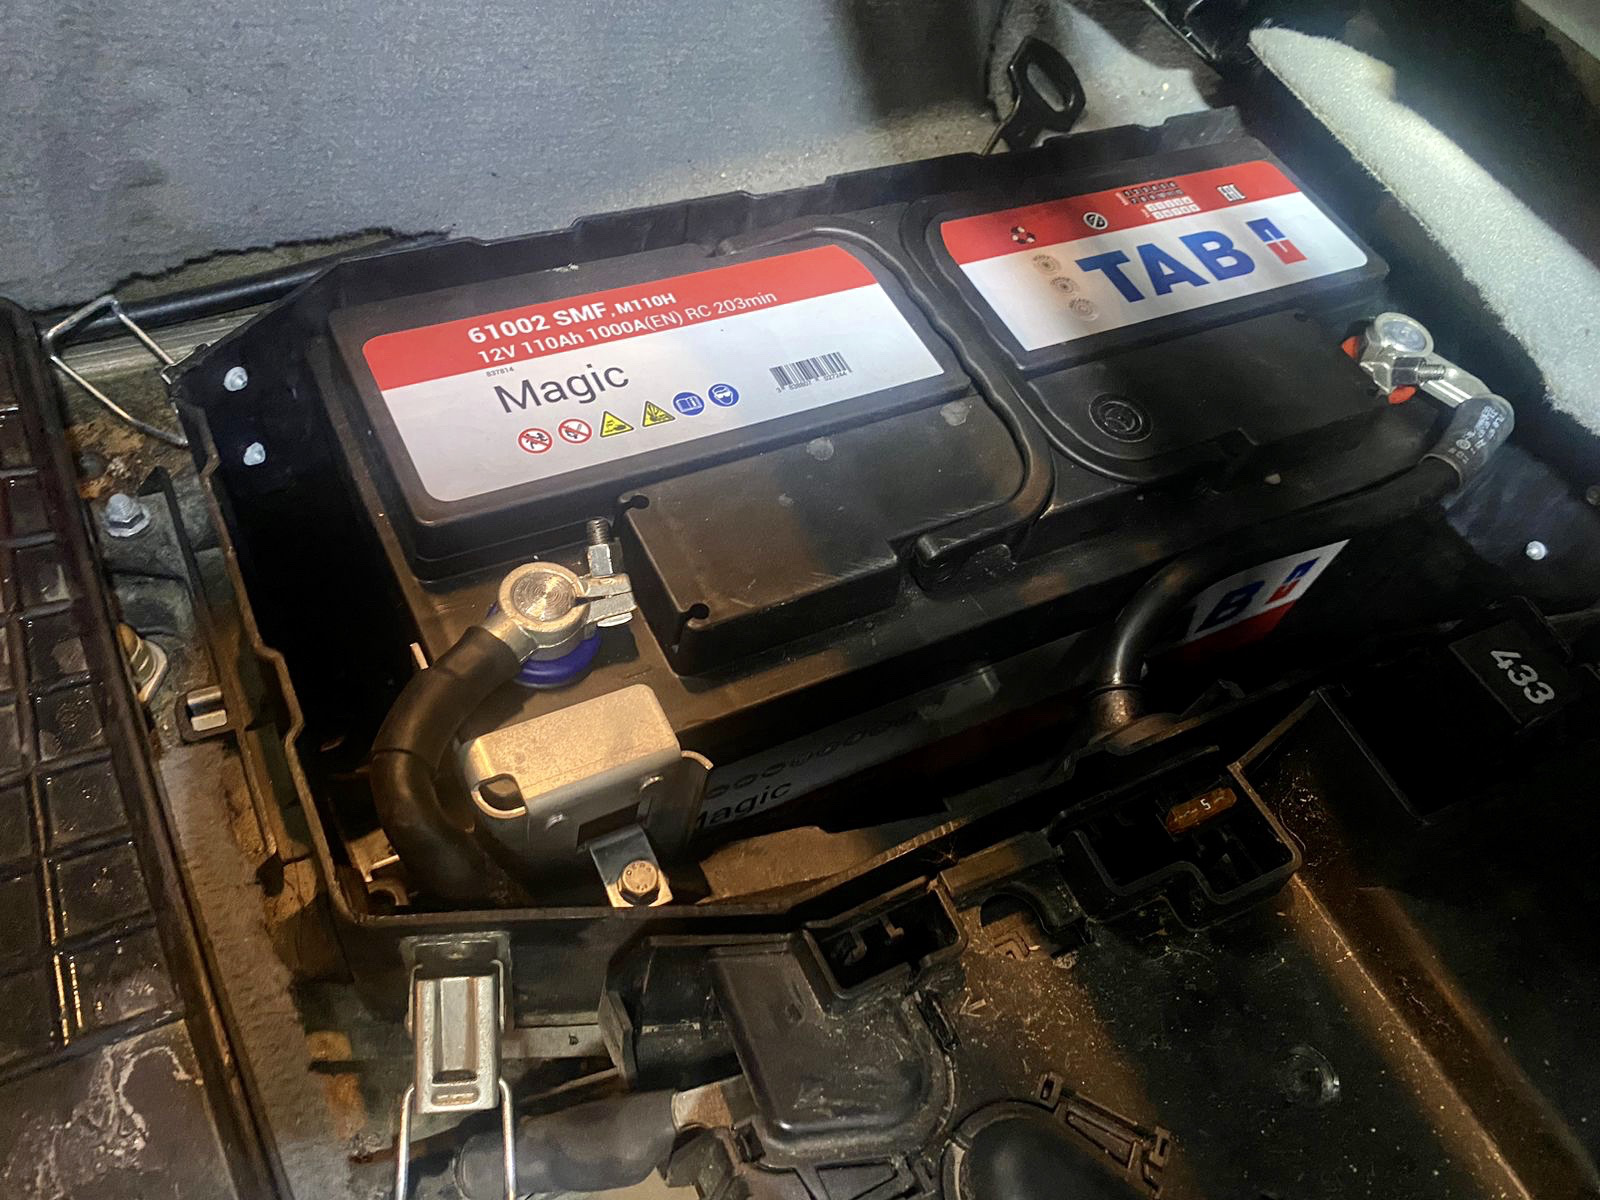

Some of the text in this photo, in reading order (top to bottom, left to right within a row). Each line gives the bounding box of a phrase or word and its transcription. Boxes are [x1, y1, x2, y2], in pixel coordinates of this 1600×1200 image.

[1075, 230, 1255, 303] TAB
[467, 315, 550, 344] 61002
[615, 292, 676, 314] M110H
[478, 291, 777, 363] 12V 110Ah 1000A(EN) RC 203min
[494, 363, 629, 413] Magic
[1490, 650, 1555, 704] 433
[1200, 799, 1211, 810] 5
